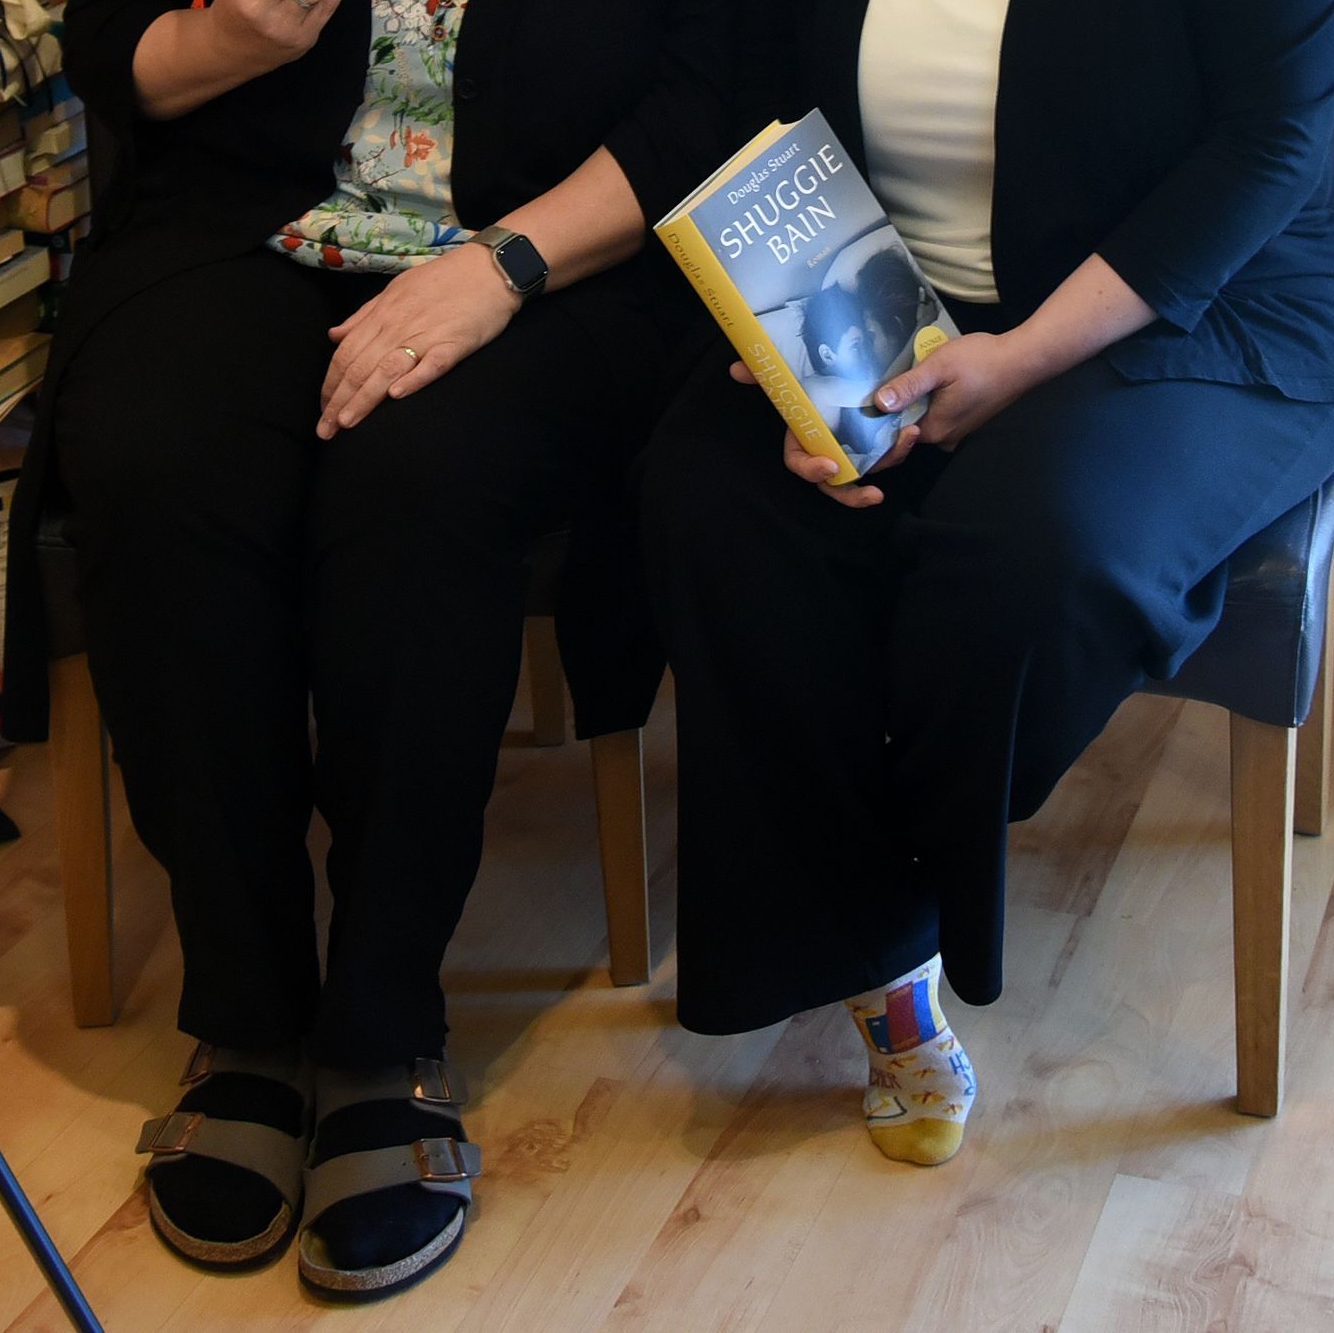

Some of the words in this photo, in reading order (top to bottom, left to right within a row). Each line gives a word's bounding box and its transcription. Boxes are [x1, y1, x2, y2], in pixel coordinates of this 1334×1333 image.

[720, 143, 844, 259] SHUGGIE
[727, 162, 770, 206] Douglas
[766, 141, 800, 171] Stuart
[667, 231, 704, 290] Douglas
[706, 288, 735, 329] Stuart
[766, 196, 838, 266] BAIN
[748, 342, 824, 442] SHUGGIE
